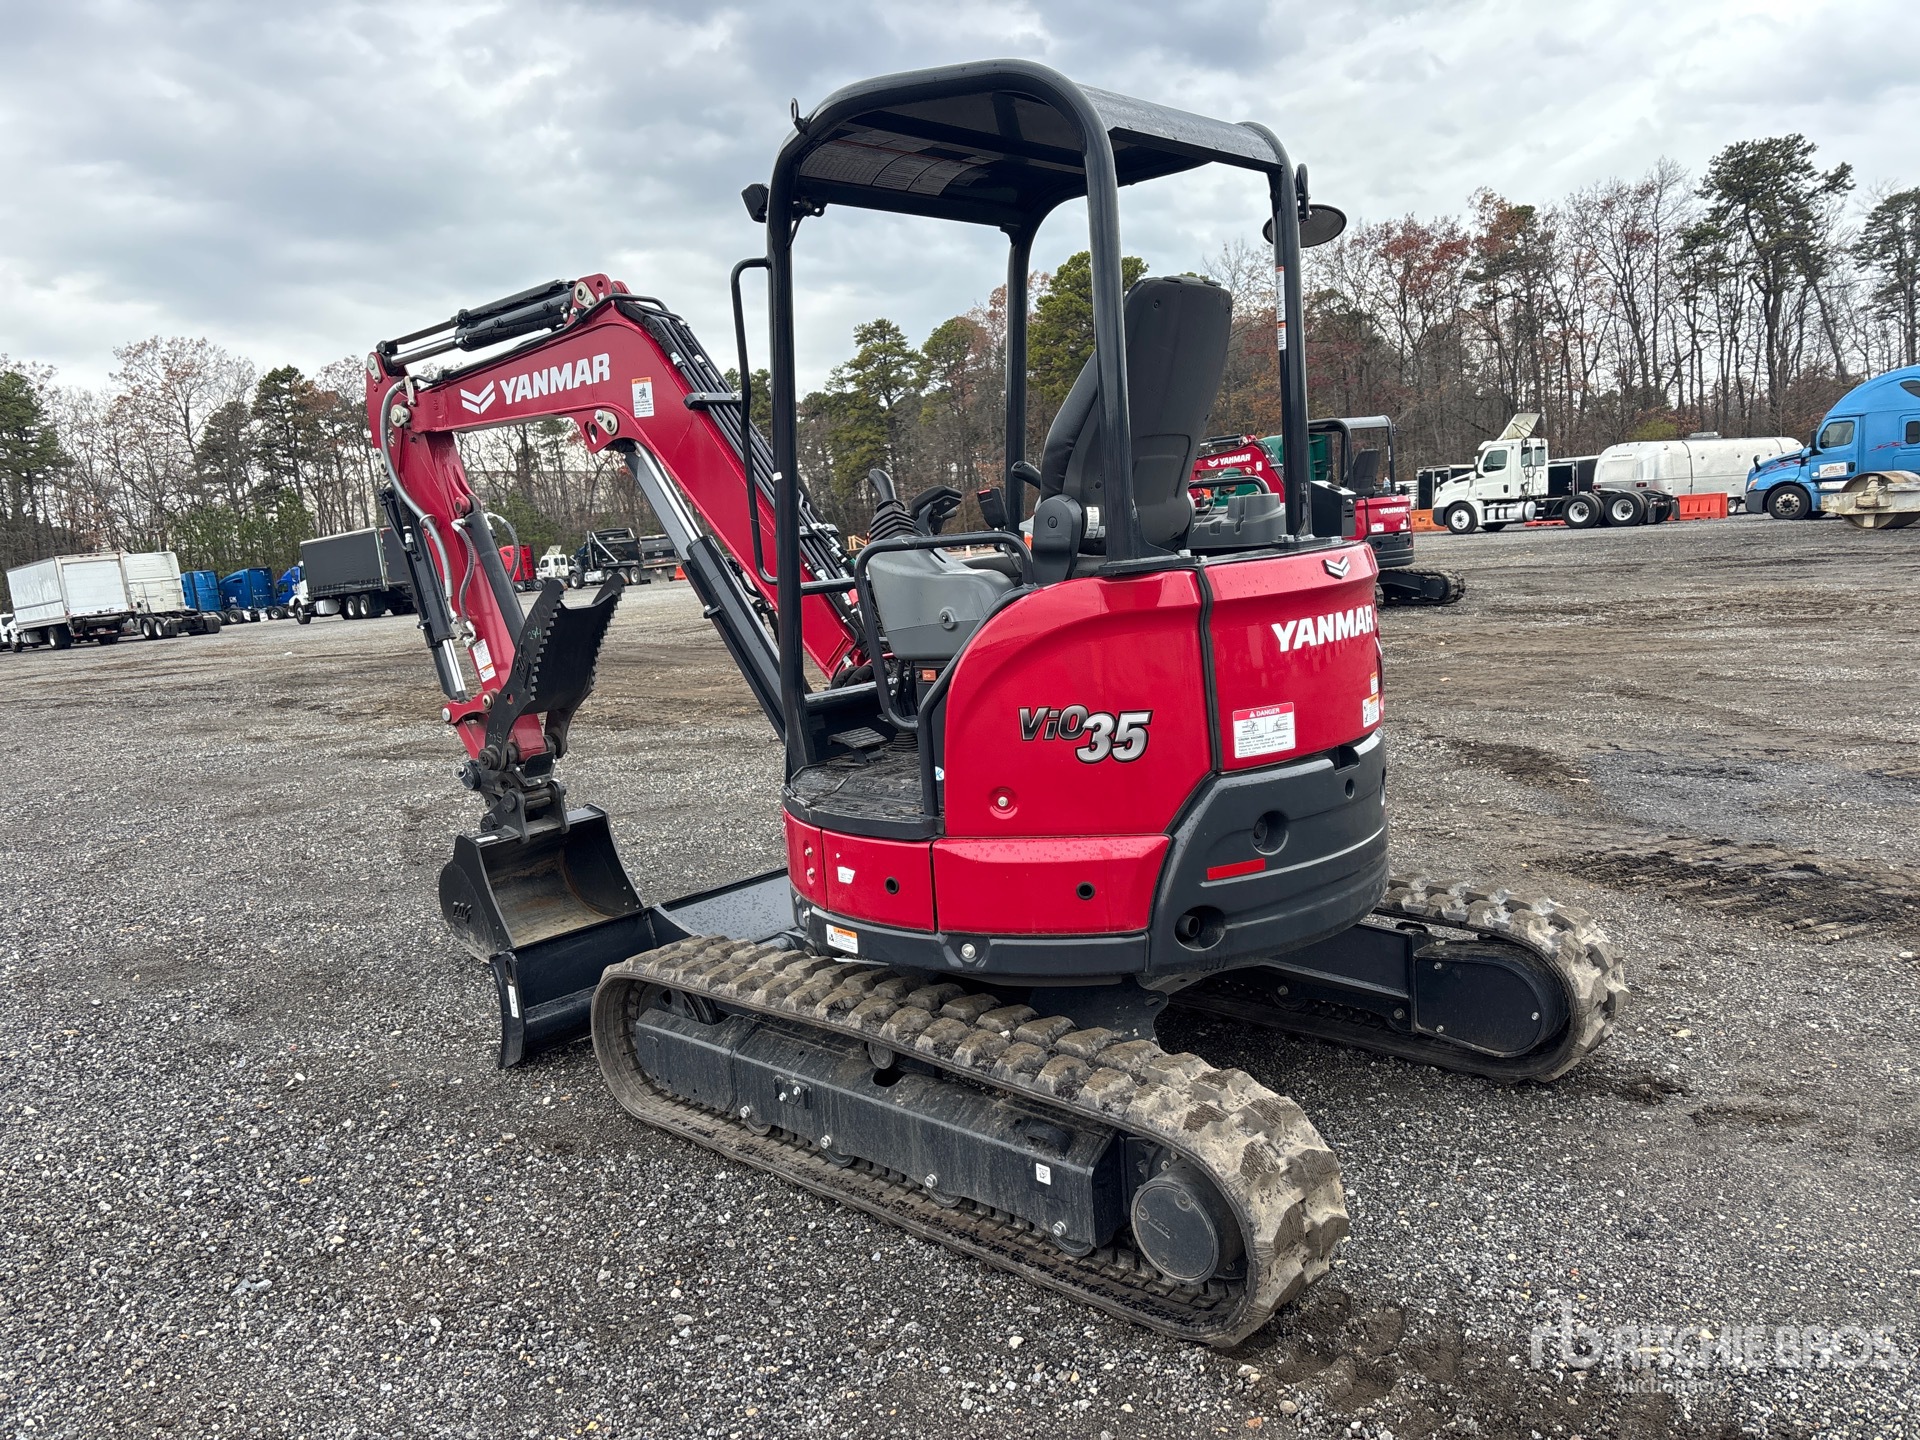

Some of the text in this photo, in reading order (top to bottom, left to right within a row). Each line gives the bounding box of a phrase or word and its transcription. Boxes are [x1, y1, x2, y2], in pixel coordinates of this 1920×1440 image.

[499, 352, 611, 405] YANMAR
[1219, 454, 1251, 466] YANMAR
[1271, 605, 1374, 652] YANMAR
[1255, 707, 1281, 717] DANGER
